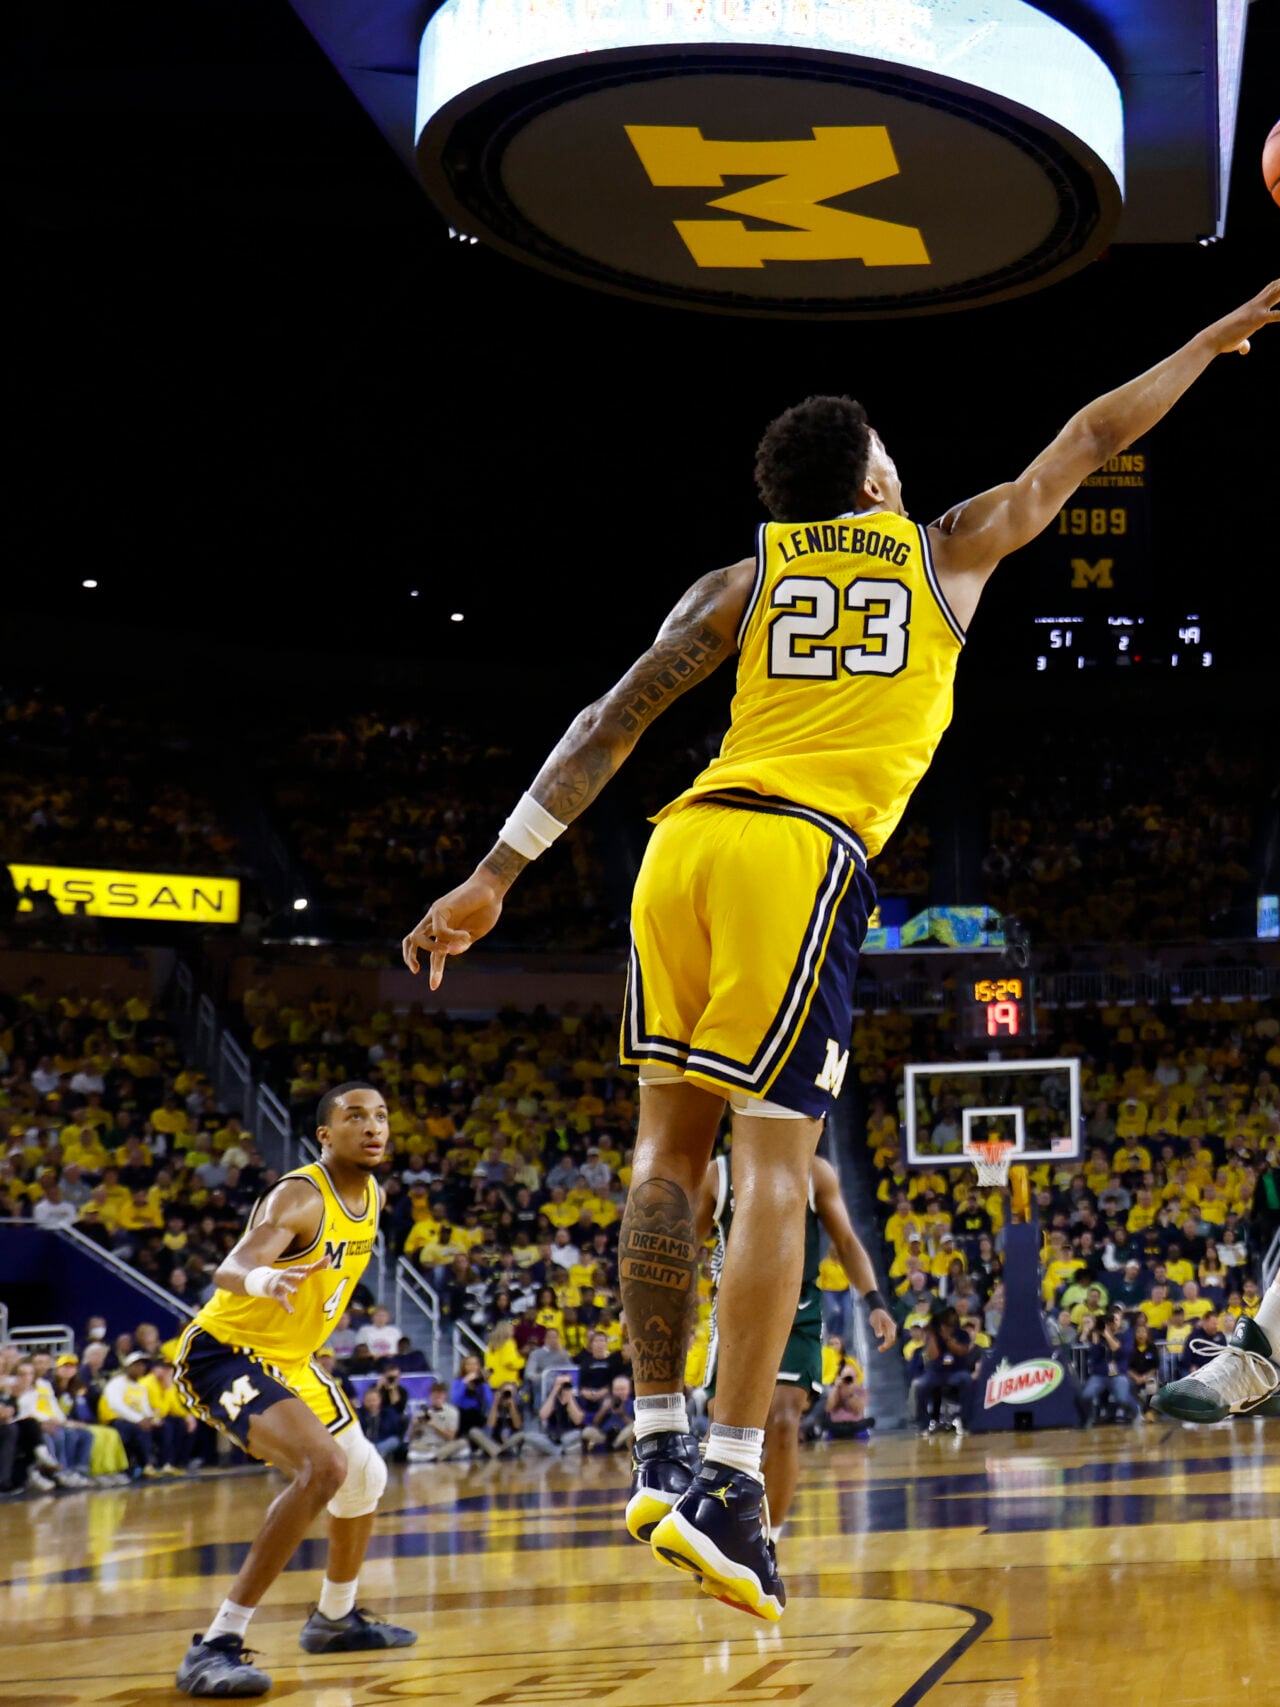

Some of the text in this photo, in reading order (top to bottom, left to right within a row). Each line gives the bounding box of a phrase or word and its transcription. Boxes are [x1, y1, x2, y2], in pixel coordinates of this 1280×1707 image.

[623, 125, 931, 268] M
[1057, 506, 1128, 536] 1989
[778, 525, 911, 567] LENDEBORG
[1070, 557, 1116, 590] M
[767, 575, 912, 680] 23
[1050, 629, 1073, 648] 51
[1118, 635, 1130, 651] 2
[1178, 626, 1201, 645] 49
[1036, 651, 1212, 671] 3 1 1 3
[26, 876, 223, 912] SSAN
[974, 978, 1023, 1002] 15:29
[987, 1001, 1019, 1037] 19
[632, 1231, 690, 1260] DREAMS
[629, 1261, 686, 1286] REALITY
[322, 1275, 350, 1322] 4
[219, 1374, 261, 1422] M
[987, 1366, 1056, 1405] LIBMAN
